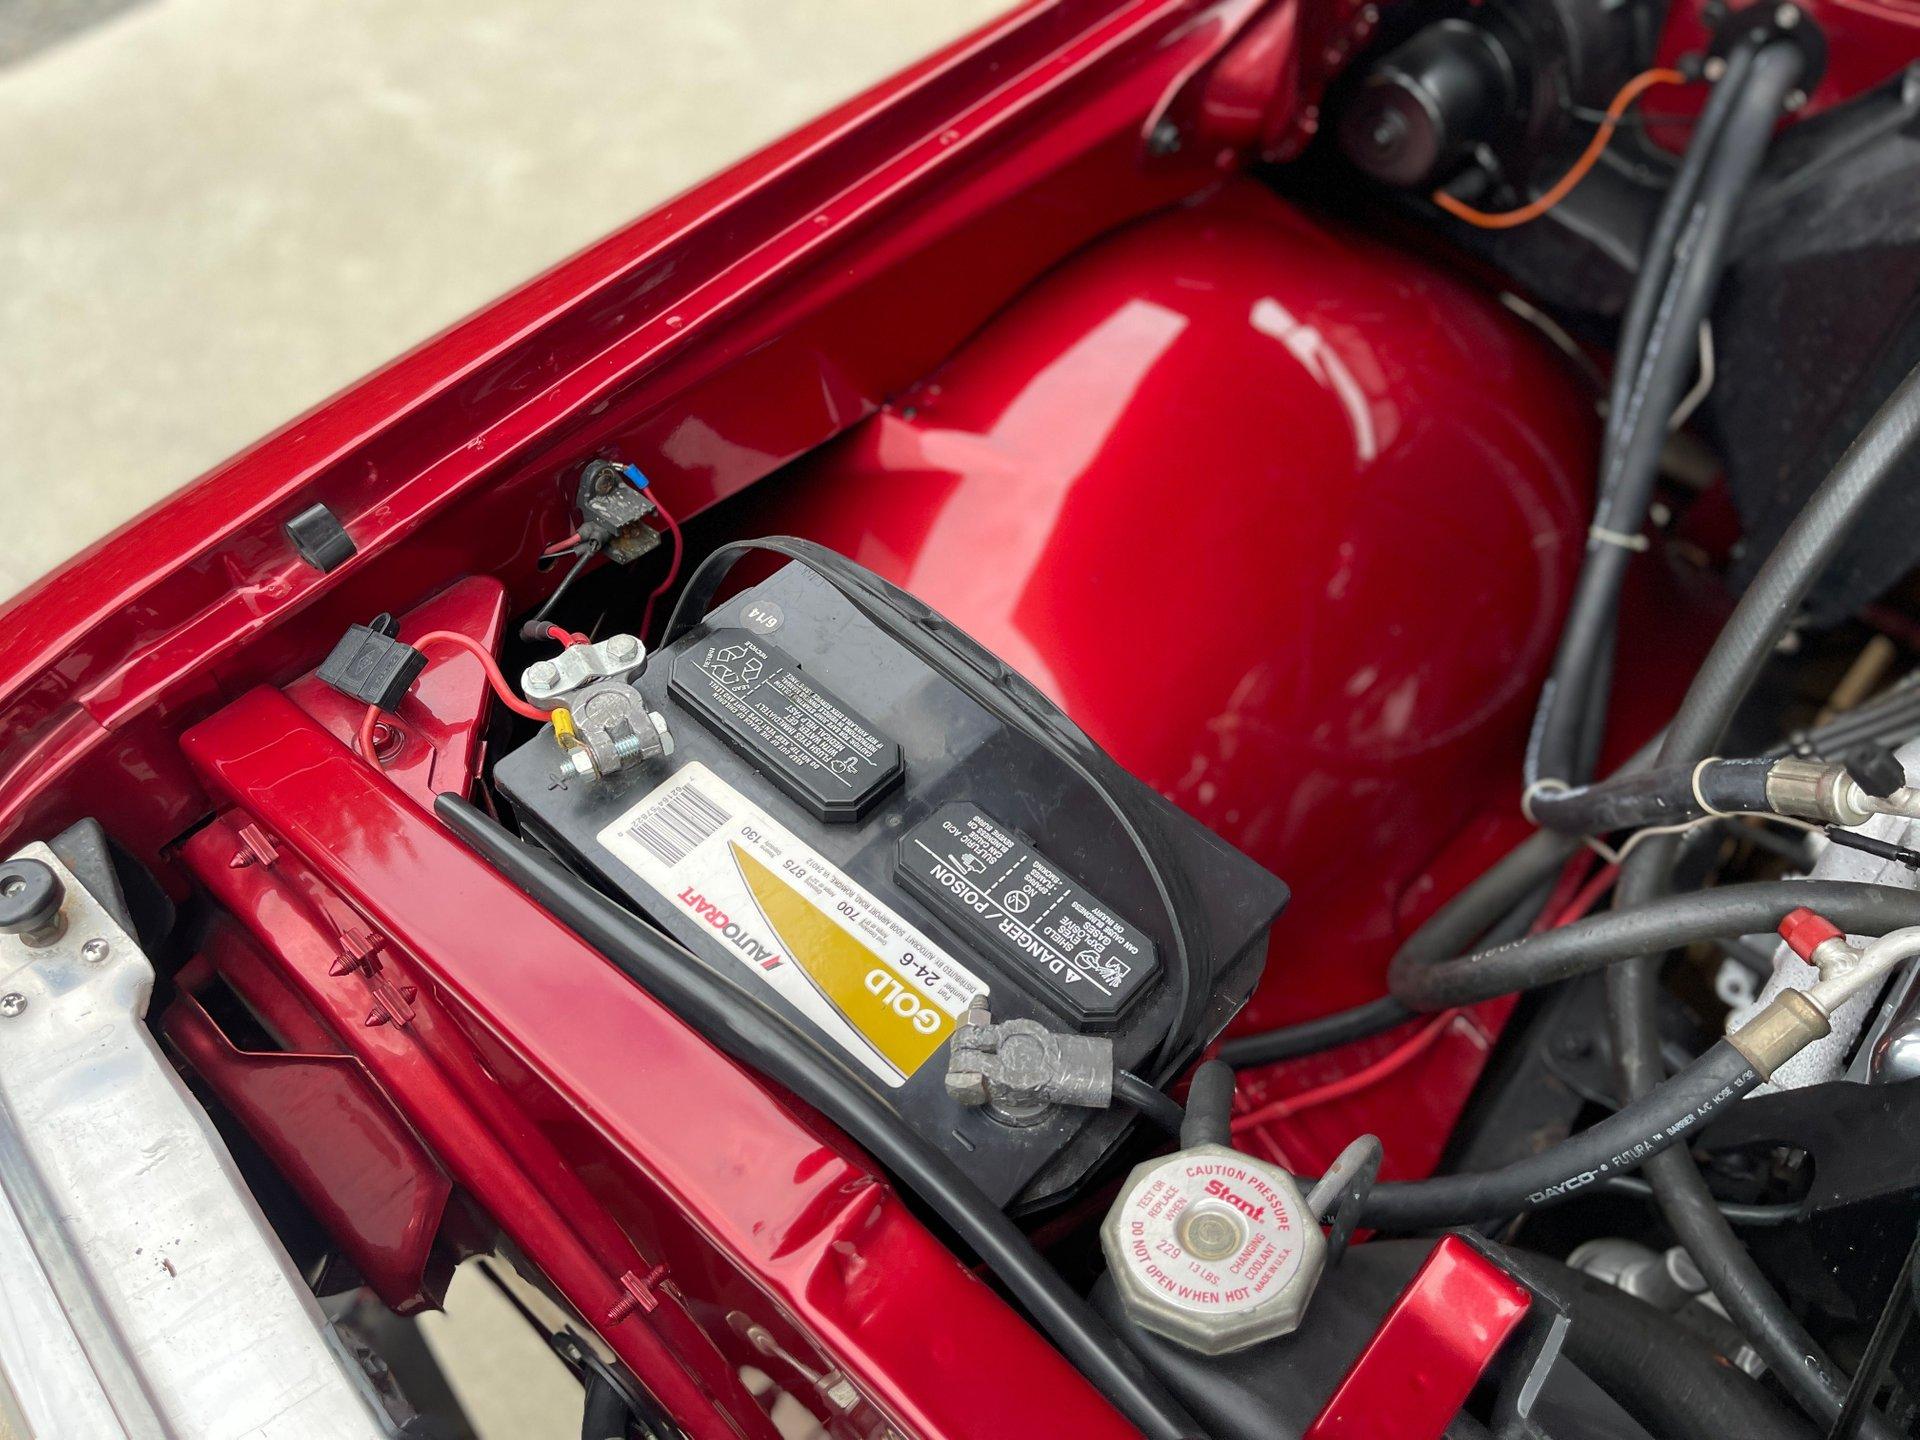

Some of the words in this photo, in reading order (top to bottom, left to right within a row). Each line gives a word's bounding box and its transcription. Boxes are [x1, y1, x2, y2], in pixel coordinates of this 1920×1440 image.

[747, 607, 778, 628] 6/14
[744, 640, 767, 659] RECYCLE
[711, 691, 738, 713] CHILDREN
[784, 704, 803, 718] FAST
[742, 716, 762, 732] REACH
[754, 699, 796, 734] IMMEDIATELY
[782, 713, 798, 725] GET
[800, 717, 819, 731] HELP
[759, 730, 772, 740] THE
[769, 737, 779, 746] OF
[793, 731, 812, 747] EYES
[817, 727, 845, 751] MEDICAL
[777, 744, 790, 754] OUT
[808, 743, 832, 762] FLUSH
[819, 741, 838, 756] WITH
[788, 754, 804, 765] KEEP
[942, 820, 962, 836] ACID
[966, 819, 978, 829] OR
[972, 814, 993, 831] BURNS
[740, 826, 761, 843] 130
[968, 830, 989, 848] CAUSE
[976, 827, 1008, 853] BLINDNESS
[990, 828, 1014, 847] SEVERE
[960, 834, 997, 864] SULFURIC
[987, 845, 1002, 858] CAN
[782, 858, 806, 877] 875
[1032, 860, 1060, 883] SMOKING
[929, 864, 988, 912] POISON
[1023, 873, 1048, 894] SPARKS
[1030, 868, 1054, 888] FLAMES
[1022, 883, 1038, 897] NO
[836, 901, 859, 920] 700
[868, 906, 891, 925] AIRPORT
[1071, 900, 1105, 928] BLINDNESS
[1091, 907, 1114, 925] INJURY
[678, 886, 771, 965] AUTOCRAFT
[1057, 924, 1081, 944] EYES
[1059, 915, 1105, 952] EXPLOSIVE
[1082, 921, 1111, 945] GASES
[1102, 925, 1124, 943] CAUSE
[1112, 922, 1124, 933] OR
[904, 935, 935, 959] AUTOCRAFT
[998, 918, 1064, 973] DANGER
[1043, 926, 1073, 951] SHIELD
[1123, 940, 1138, 954] CAN
[899, 952, 940, 985] 24-6
[942, 965, 976, 993] DISTRIBUTED
[865, 968, 942, 1035] GOLD
[937, 987, 951, 1000] Part
[943, 982, 967, 1002] Number
[1528, 1170, 1595, 1202] DAYCO
[1611, 1139, 1654, 1165] FUTURA
[1665, 1112, 1696, 1136] BARRIER
[1696, 1101, 1713, 1116] A/C
[1711, 1086, 1733, 1104] HOSE
[1137, 1186, 1158, 1209] TEST
[1154, 1180, 1166, 1193] OR
[1147, 1184, 1179, 1220] REPLACE
[1186, 1165, 1246, 1181] CAUTION
[1248, 1177, 1290, 1231] PRESSURE
[1204, 1179, 1265, 1221] Stant
[1164, 1197, 1188, 1221] WHEN
[1131, 1221, 1144, 1236] DO
[1133, 1239, 1152, 1262] NOT
[1156, 1239, 1181, 1259] 229
[1229, 1232, 1266, 1274] CHANGING
[1189, 1261, 1201, 1273] 13
[1245, 1243, 1277, 1280] COOLANT
[1146, 1264, 1177, 1291] OPEN
[1255, 1272, 1272, 1293] MADE
[1178, 1285, 1219, 1304] WHEN
[1225, 1286, 1250, 1303] HOT
